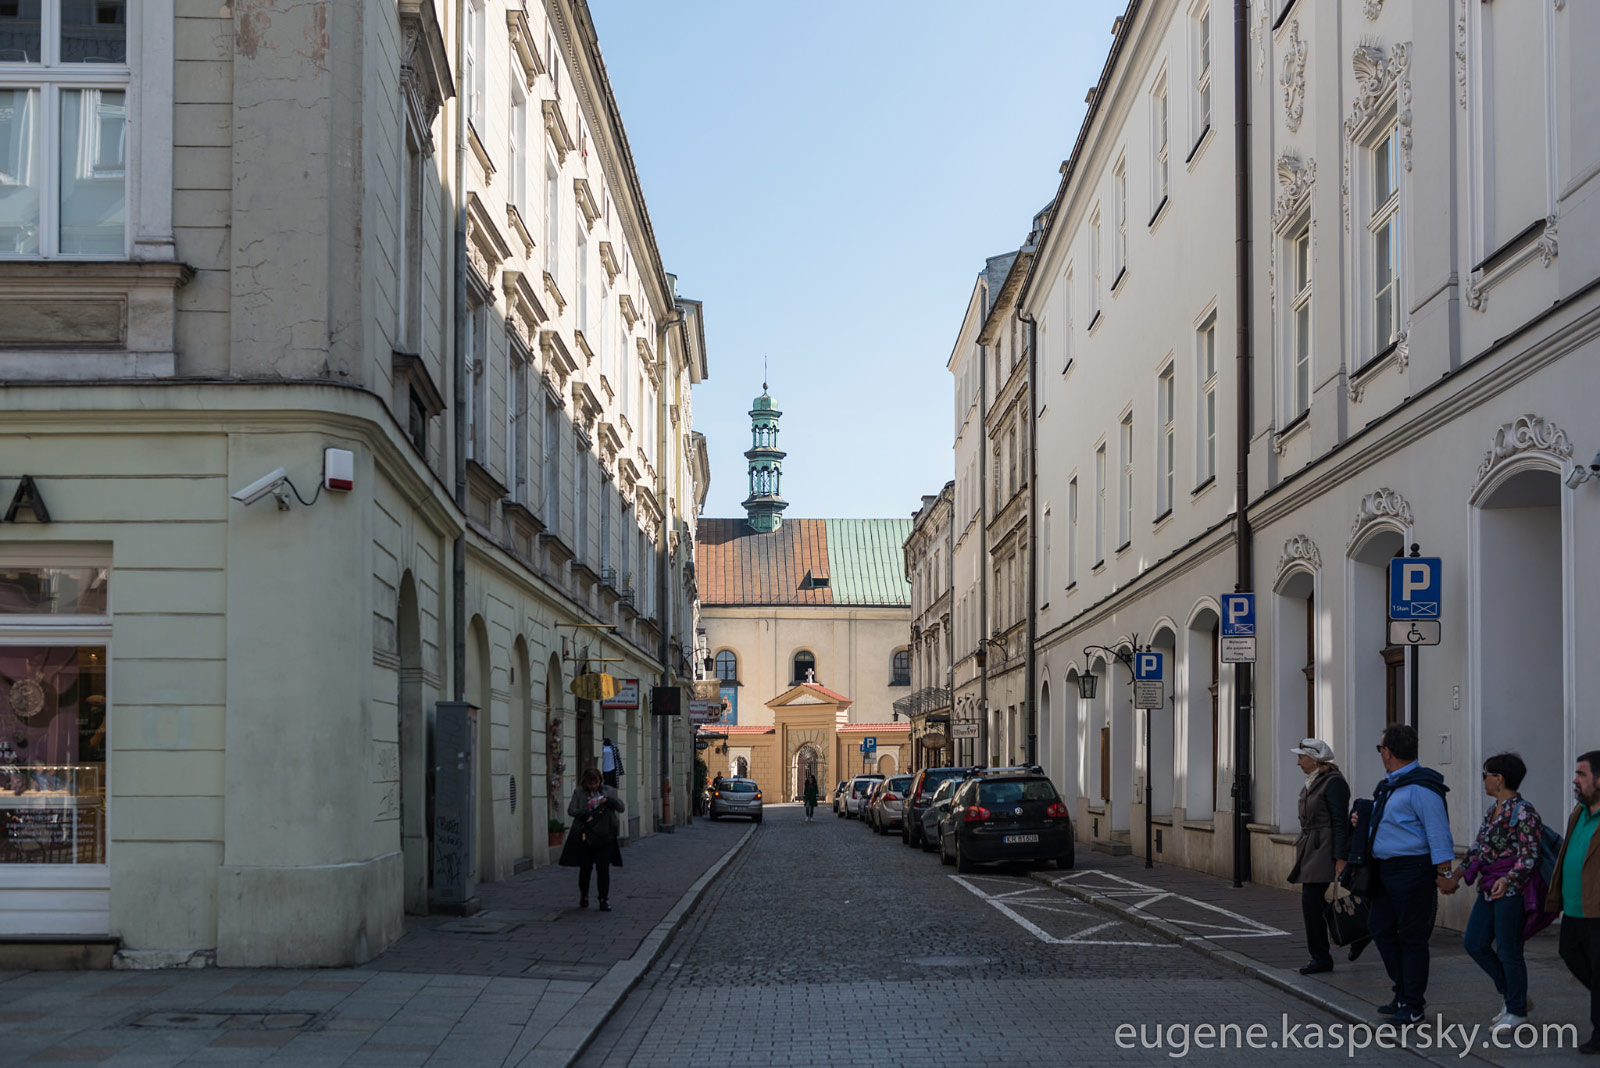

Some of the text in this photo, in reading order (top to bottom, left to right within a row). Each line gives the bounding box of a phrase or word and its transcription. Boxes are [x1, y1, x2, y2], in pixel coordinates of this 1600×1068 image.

[1402, 563, 1430, 601] P
[1229, 597, 1249, 624] P
[1141, 655, 1157, 677] P
[867, 738, 874, 748] P
